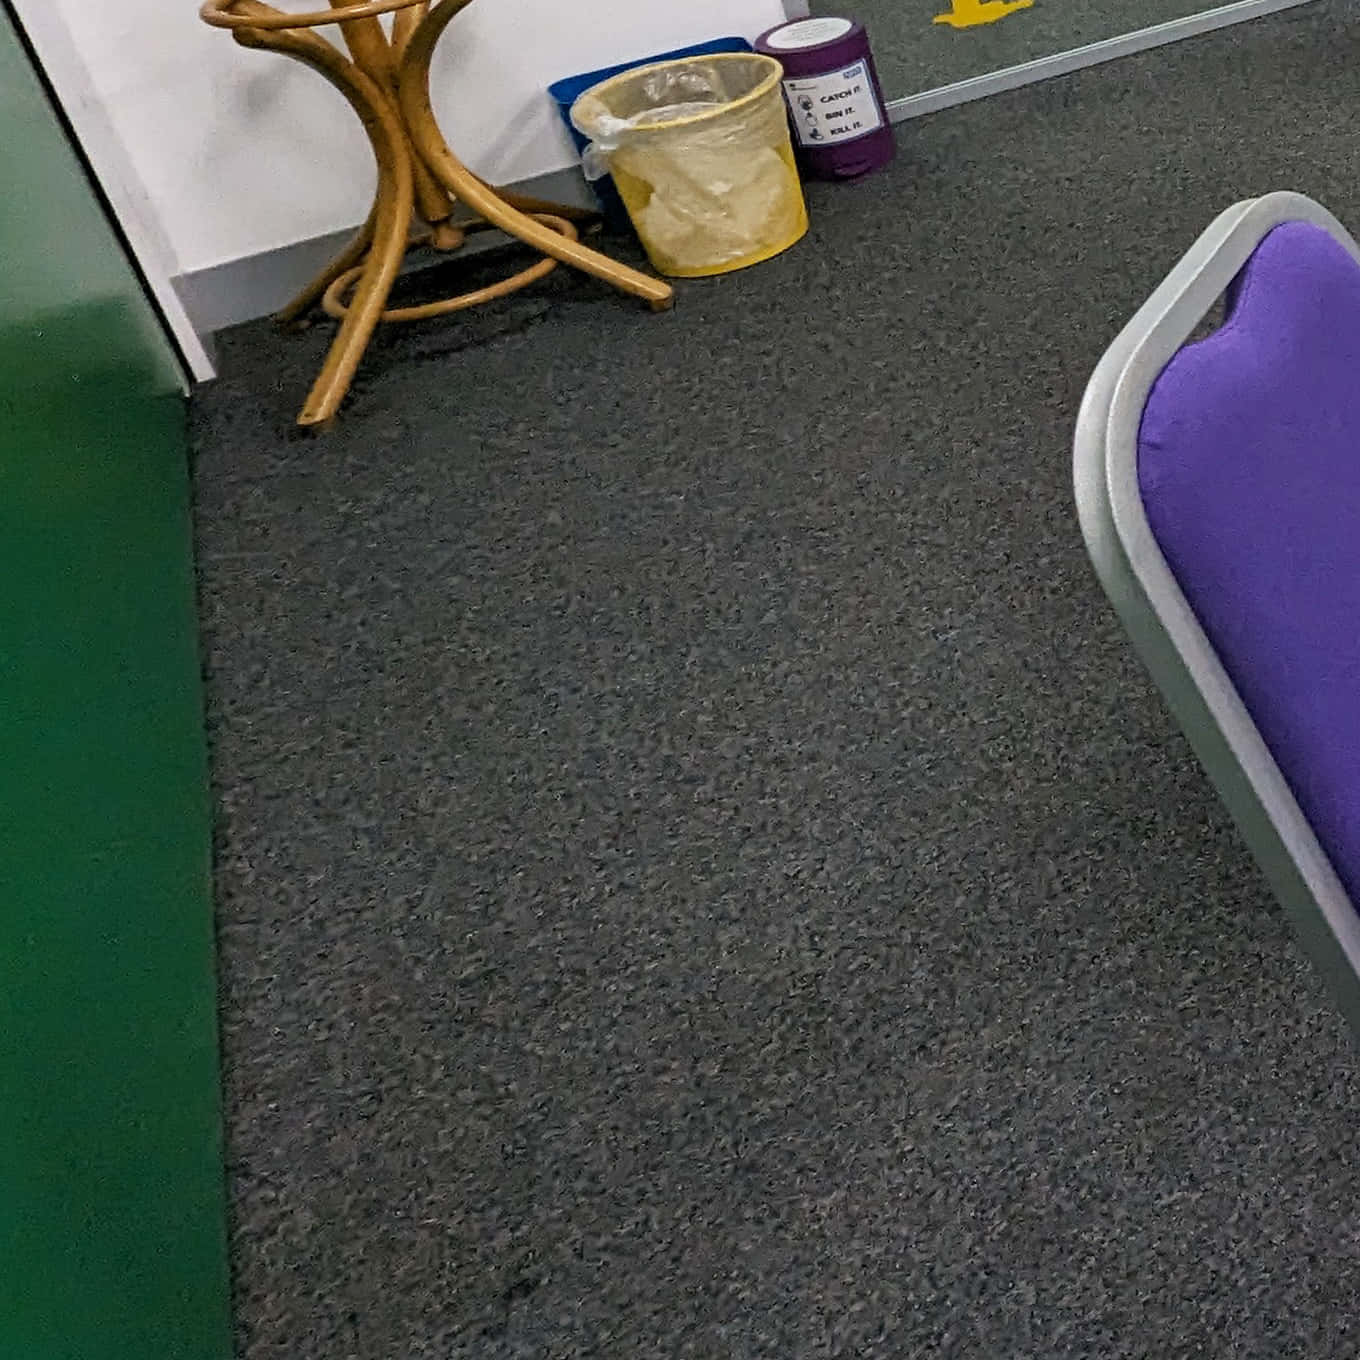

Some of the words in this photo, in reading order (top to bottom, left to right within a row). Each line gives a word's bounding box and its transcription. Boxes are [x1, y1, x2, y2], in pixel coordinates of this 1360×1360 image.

[820, 88, 852, 103] CATCH
[825, 110, 844, 121] BIN
[830, 126, 852, 137] KILL
